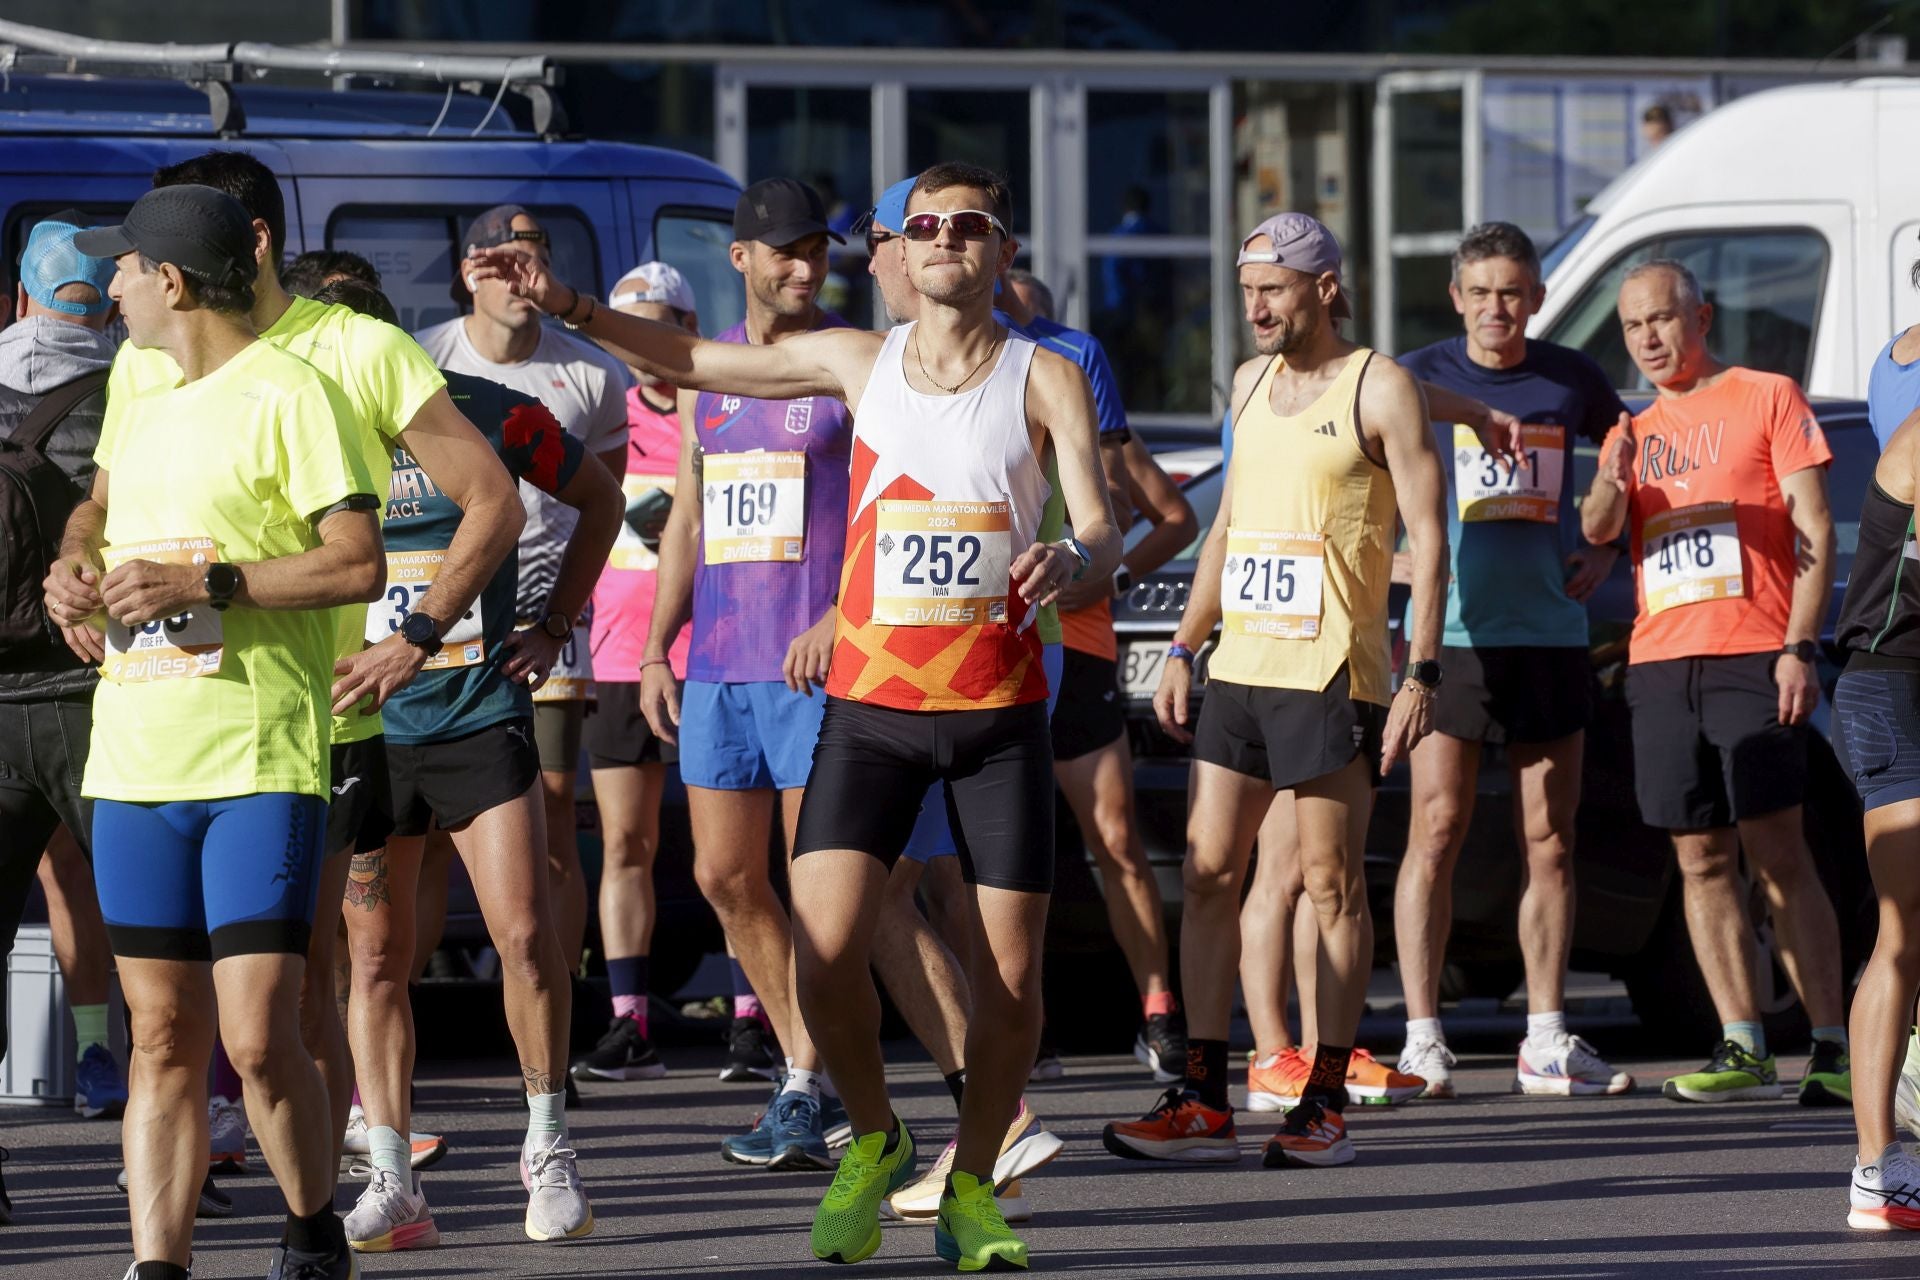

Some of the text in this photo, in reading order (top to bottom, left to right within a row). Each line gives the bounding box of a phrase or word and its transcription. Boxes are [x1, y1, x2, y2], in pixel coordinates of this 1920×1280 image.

[721, 394, 741, 414] kp
[1640, 420, 1724, 485] RUN
[723, 482, 777, 527] 169
[903, 503, 930, 513] MEDIA
[932, 503, 978, 514] MARATÓN
[980, 503, 1007, 514] AVILÉS
[928, 517, 956, 528] 2024
[142, 541, 180, 553] MARATÓN
[182, 538, 213, 550] AVILÉS
[1659, 528, 1714, 575] 408
[401, 552, 444, 564] MARATÓN
[902, 534, 981, 586] 252
[397, 567, 425, 578] 2024
[1240, 557, 1295, 602] 215
[905, 604, 975, 622] avilés
[140, 636, 155, 647] JOSE
[124, 653, 188, 677] avilés
